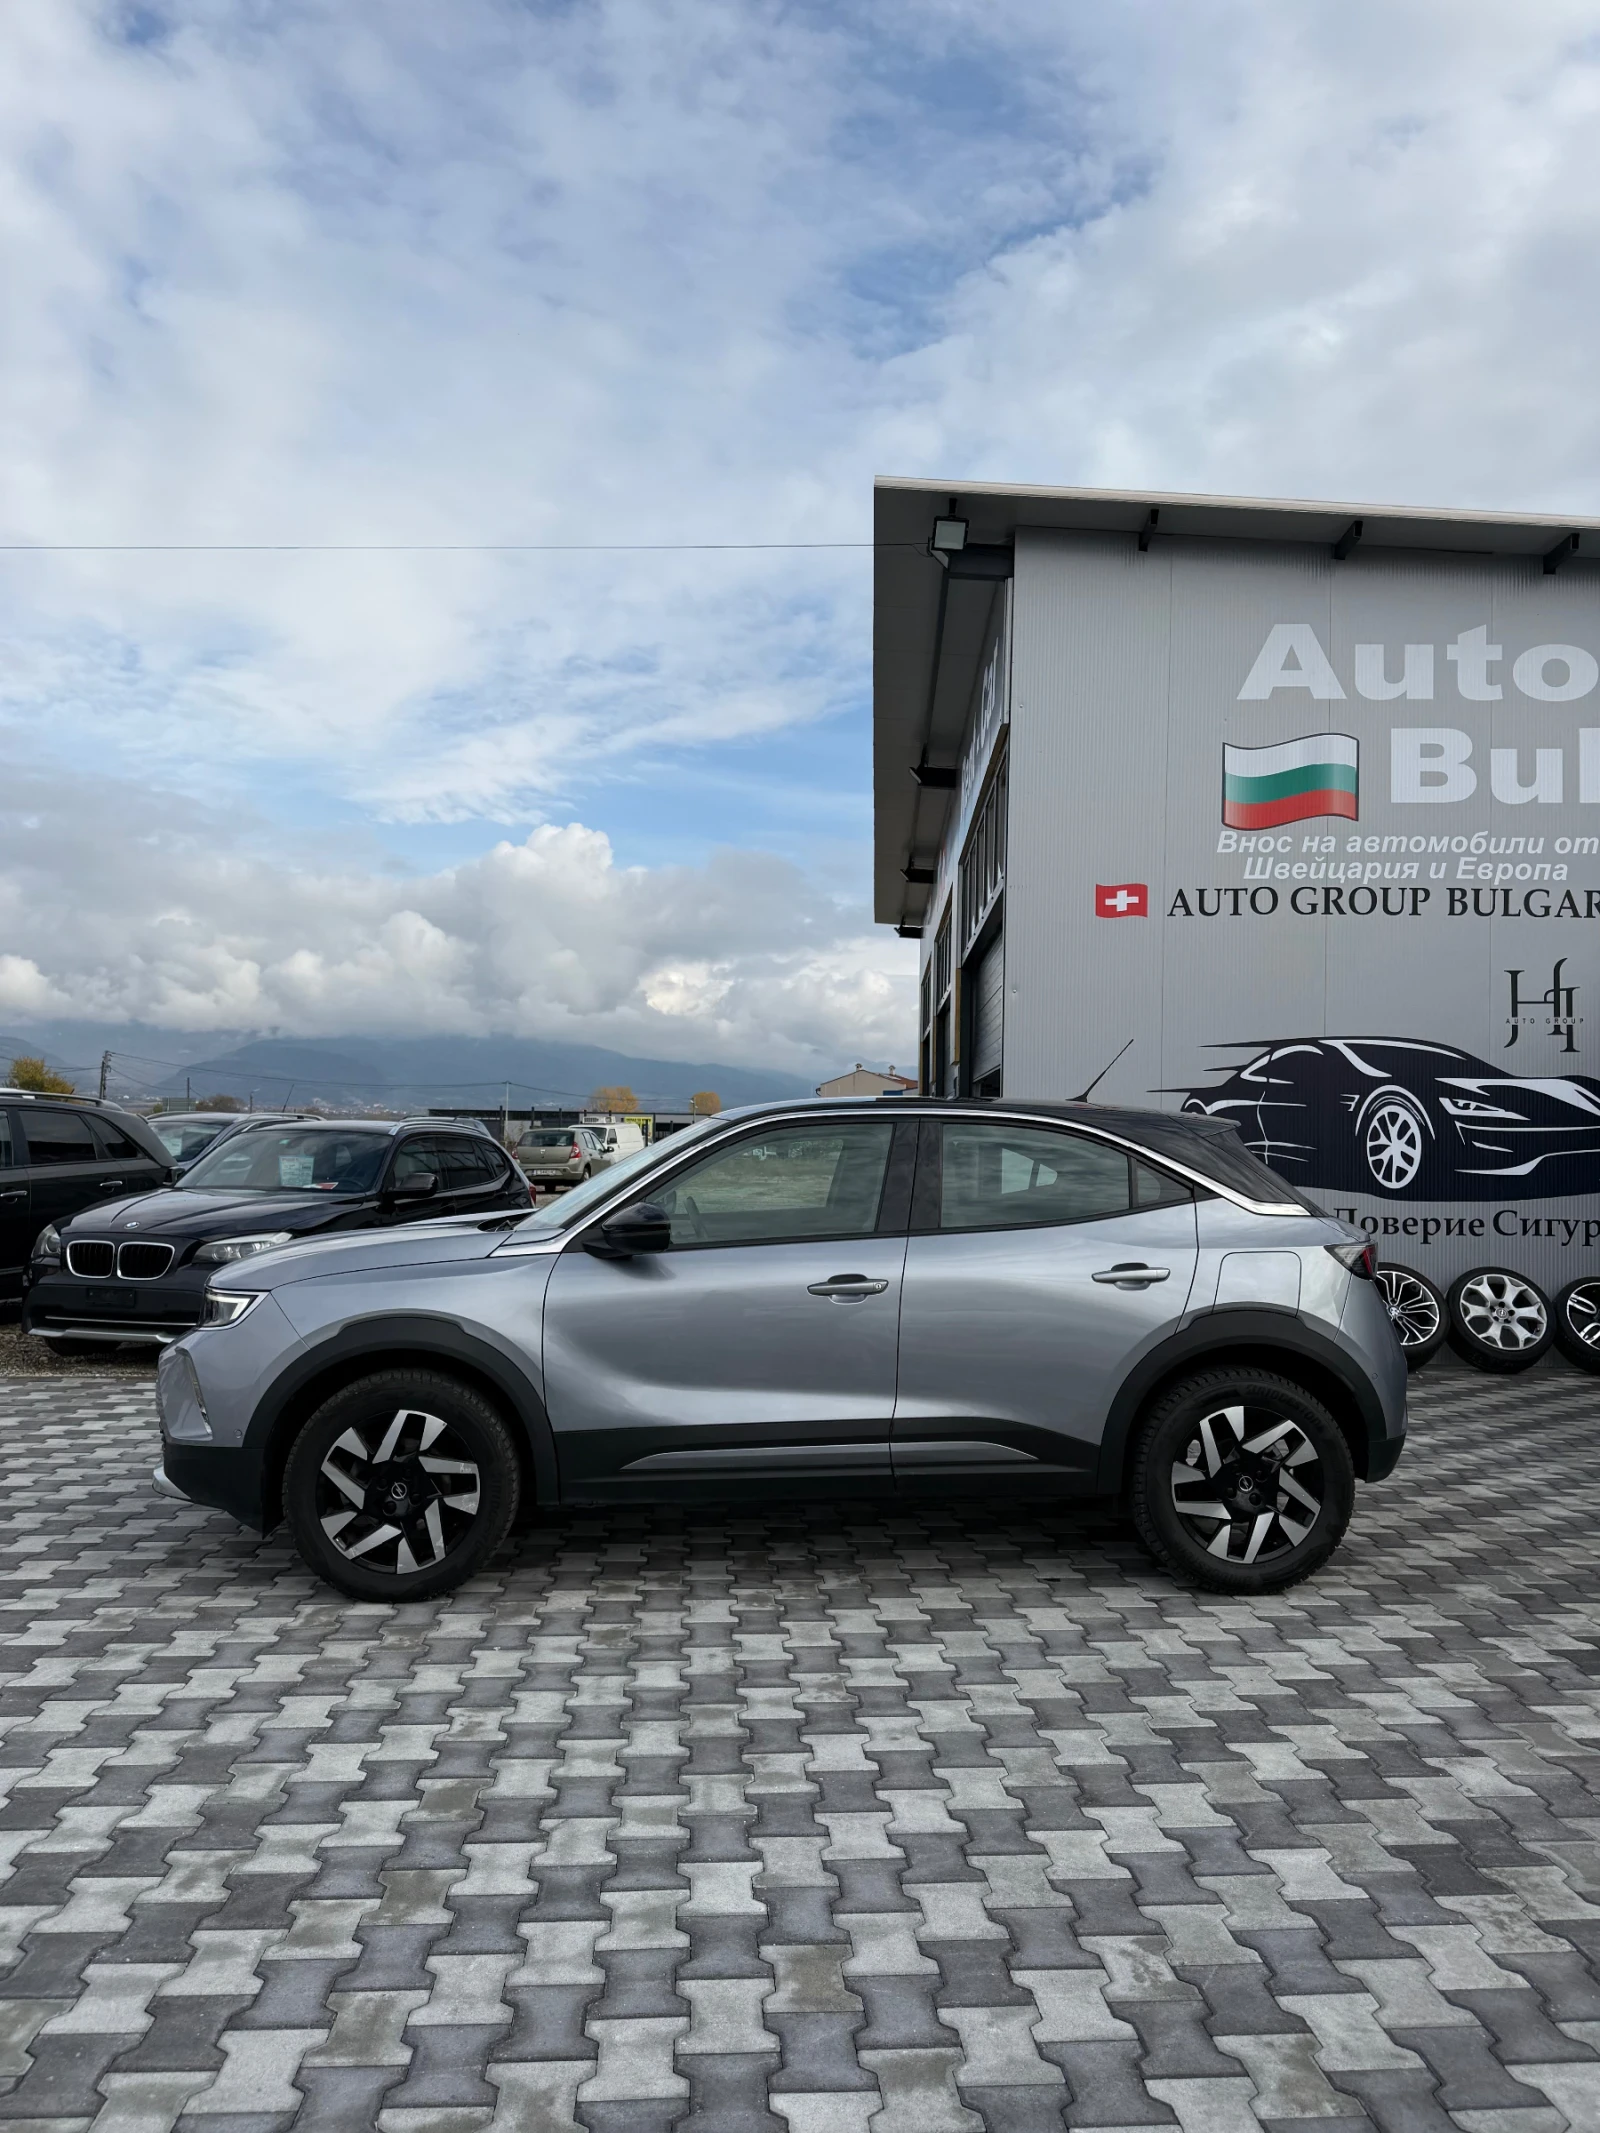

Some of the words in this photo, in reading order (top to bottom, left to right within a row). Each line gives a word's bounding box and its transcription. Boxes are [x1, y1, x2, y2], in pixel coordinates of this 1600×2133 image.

[1236, 623, 1599, 702] Auto
[1390, 727, 1600, 804] Bul
[1216, 830, 1293, 855] Внос
[1301, 836, 1337, 855] на
[1346, 830, 1545, 856] автомобили
[1554, 836, 1600, 855] от
[1242, 856, 1420, 885] Швейцария
[1428, 863, 1447, 880] и
[1455, 858, 1569, 885] Европа
[1166, 886, 1279, 917] AUTO
[1289, 886, 1431, 917] GROUP
[1492, 1209, 1600, 1247] Сигур
